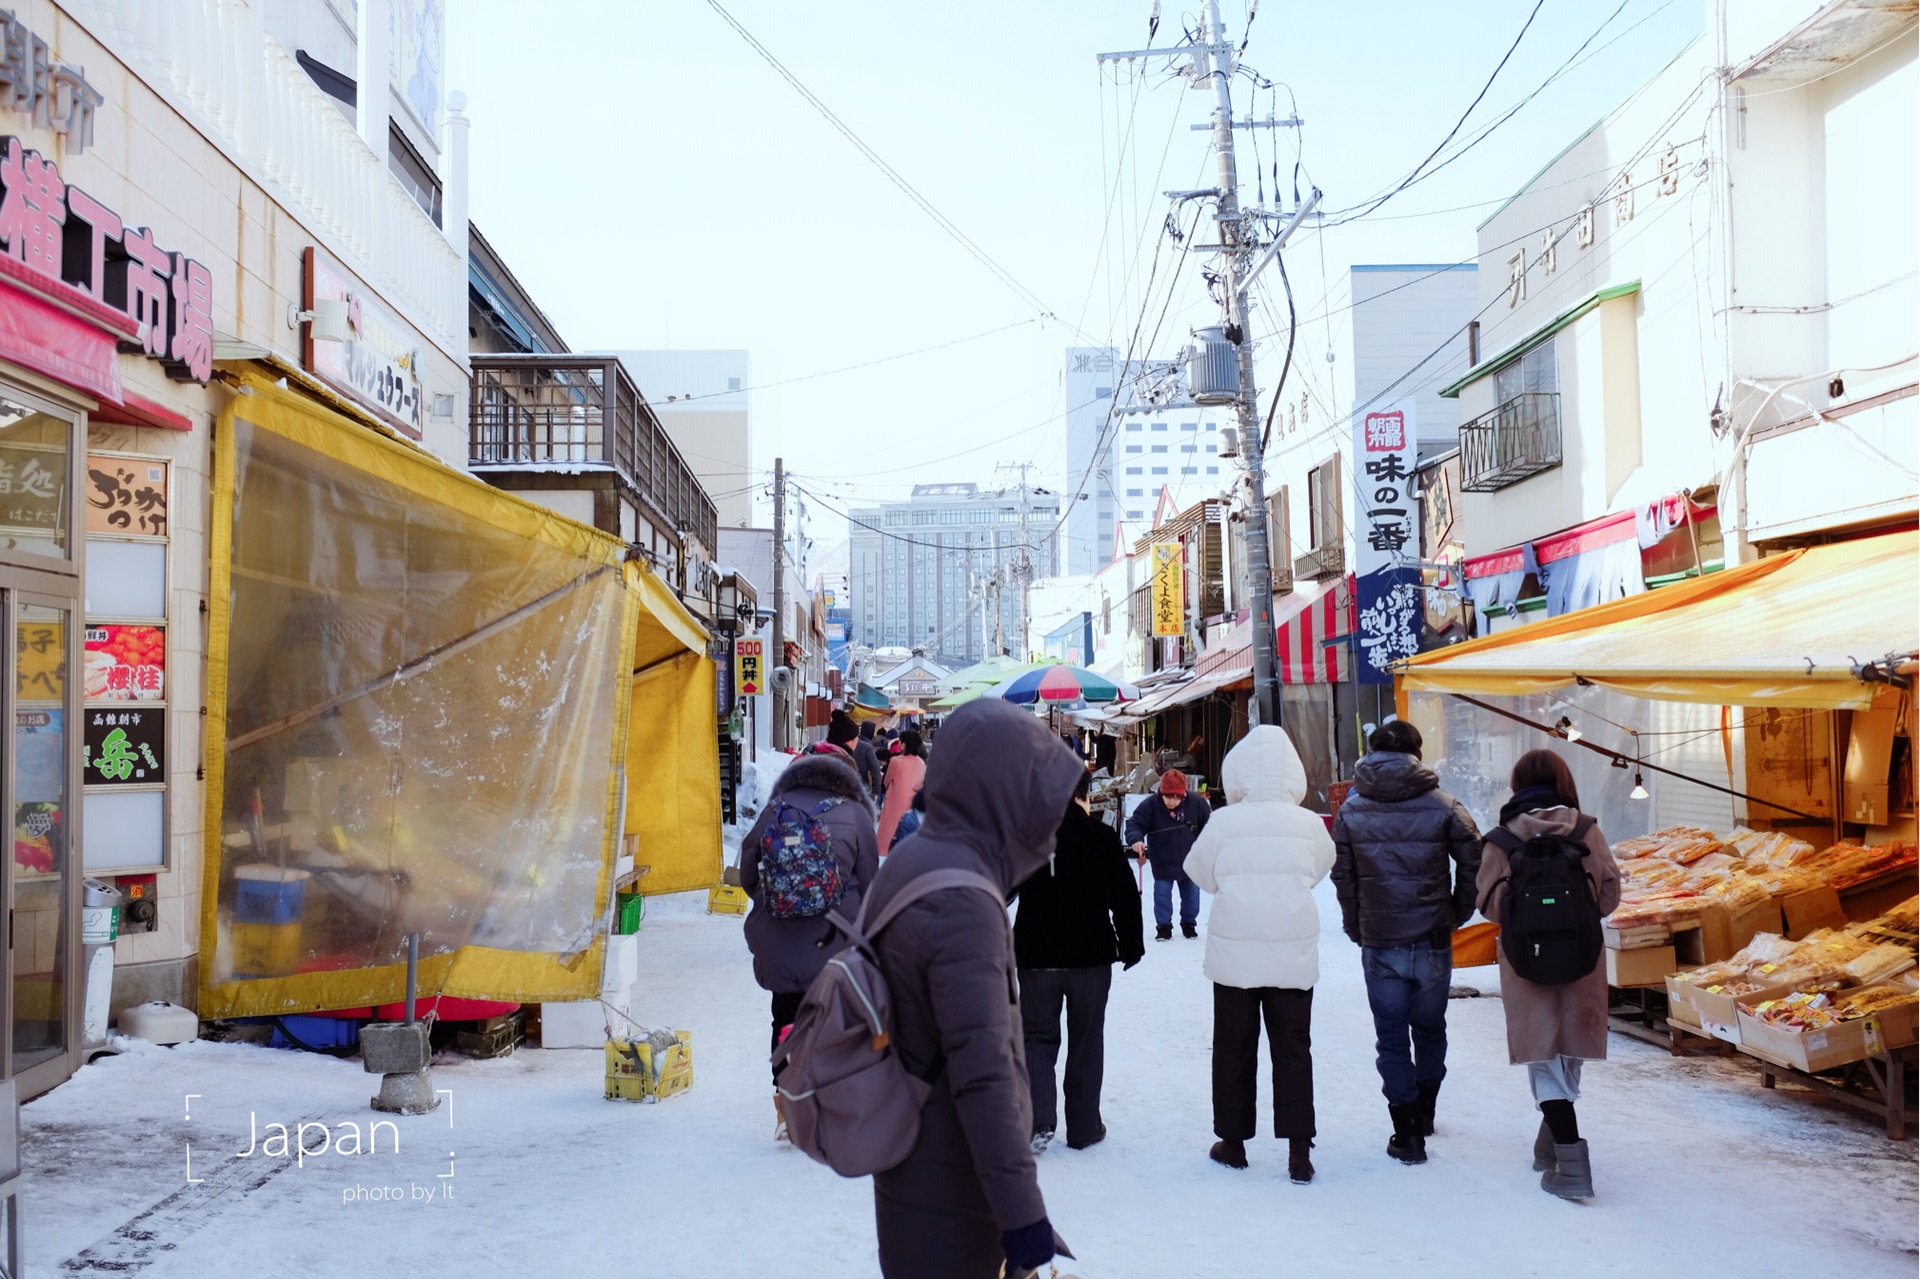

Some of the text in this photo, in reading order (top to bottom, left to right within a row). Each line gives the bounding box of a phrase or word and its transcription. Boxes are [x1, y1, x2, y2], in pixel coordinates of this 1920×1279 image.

[0, 135, 214, 382] 横丁市場
[1365, 453, 1408, 552] 味の一番
[1159, 624, 1180, 633] 本店
[85, 630, 107, 641] 鮮丼
[737, 641, 762, 656] 500
[16, 714, 46, 725] のお店
[131, 885, 143, 898] 消
